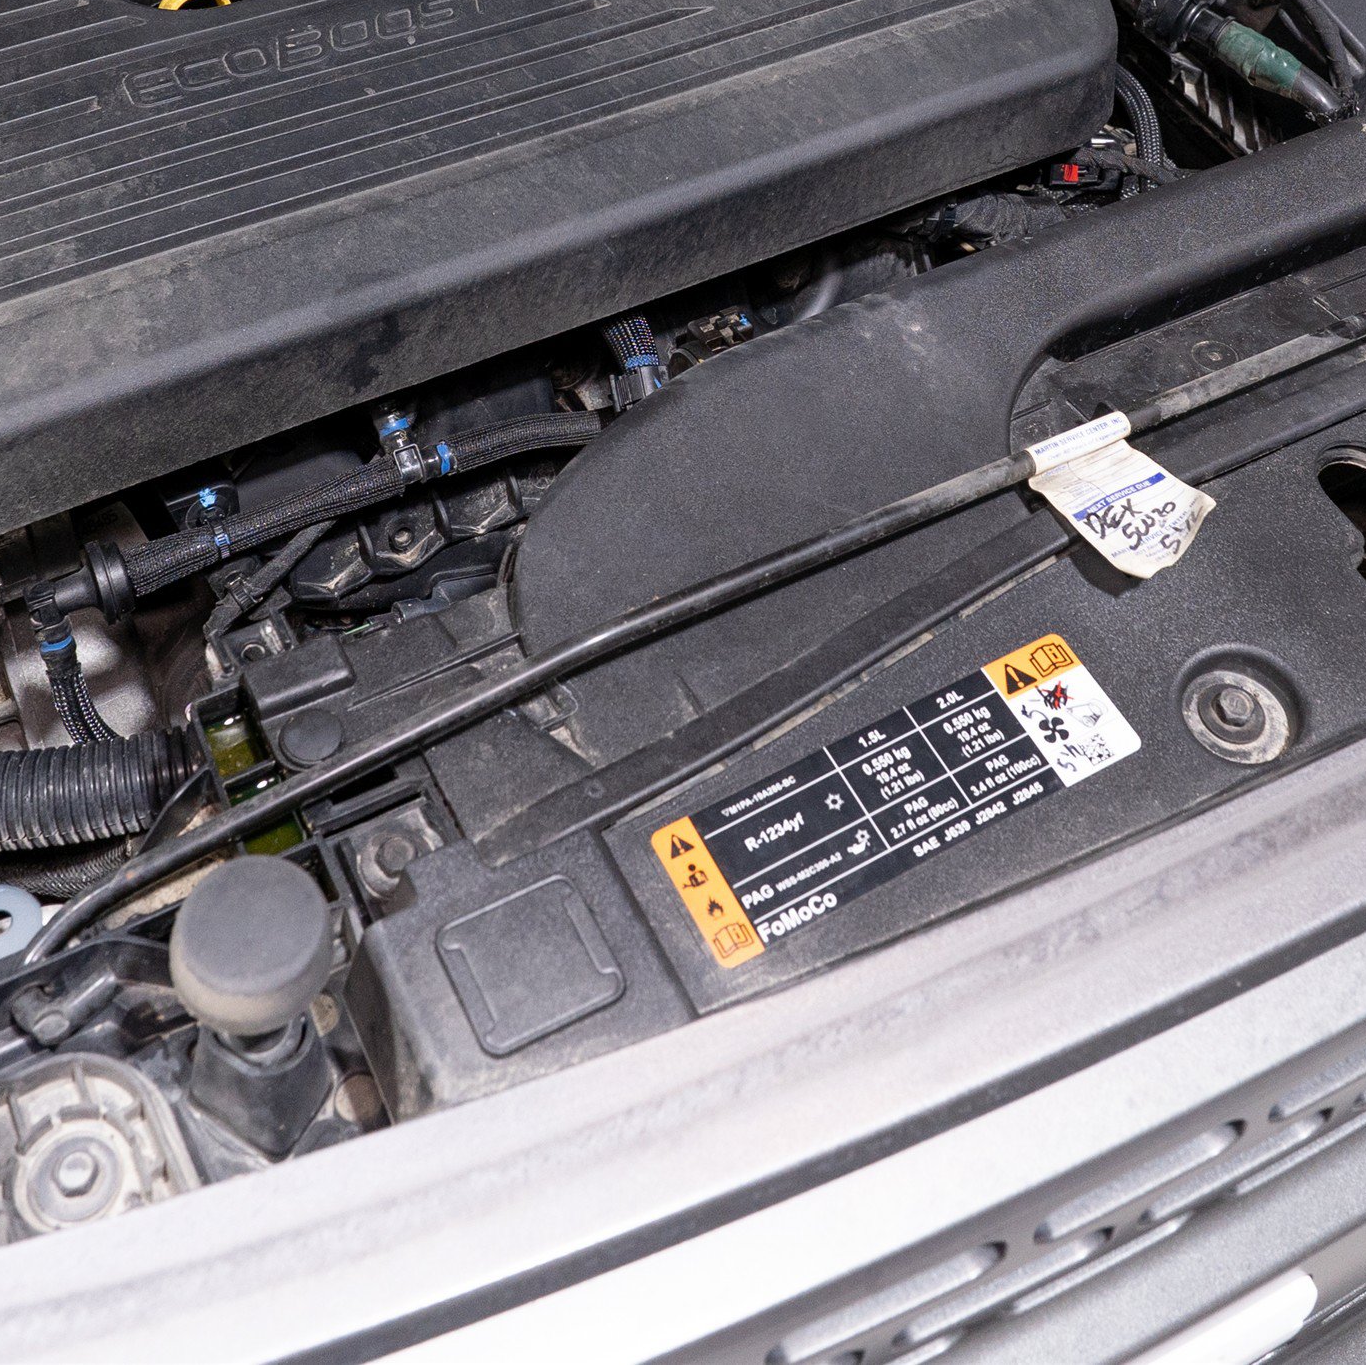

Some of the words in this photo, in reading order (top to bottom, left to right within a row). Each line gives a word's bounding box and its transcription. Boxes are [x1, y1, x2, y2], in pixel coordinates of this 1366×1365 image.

[1034, 441, 1060, 456] MARTIN
[1059, 430, 1085, 446] SERVICE
[1086, 500, 1108, 516] NEXT
[1106, 489, 1135, 507] SERVICE
[1133, 479, 1153, 495] DUE
[1083, 498, 1143, 540] DEX
[935, 689, 965, 710] 2.0L
[943, 711, 975, 736] 0.550
[973, 705, 992, 721] kg
[956, 725, 980, 744] 19.4
[977, 721, 992, 733] oz
[857, 728, 887, 749] 1.5L
[961, 738, 986, 758] (1.21
[984, 728, 1006, 747] lbs)
[861, 751, 895, 777] 0.550
[892, 745, 913, 761] kg
[875, 766, 899, 785] 19.4
[897, 761, 912, 775] oz
[969, 780, 987, 798] 3.4
[984, 775, 996, 790] fl
[994, 770, 1010, 784] oz
[1005, 752, 1043, 781] (100cc)
[984, 753, 1010, 774] PAG
[879, 779, 903, 801] (1.21
[902, 769, 926, 788] lbs)
[903, 795, 930, 816] PAG
[743, 811, 806, 853] R-1234yf
[890, 822, 908, 840] 2.7
[905, 818, 917, 832] fl
[915, 813, 931, 827] oz
[912, 835, 942, 858] SAE
[944, 818, 972, 843] J639
[740, 883, 776, 910] PAG
[756, 892, 838, 944] FoMoCo
